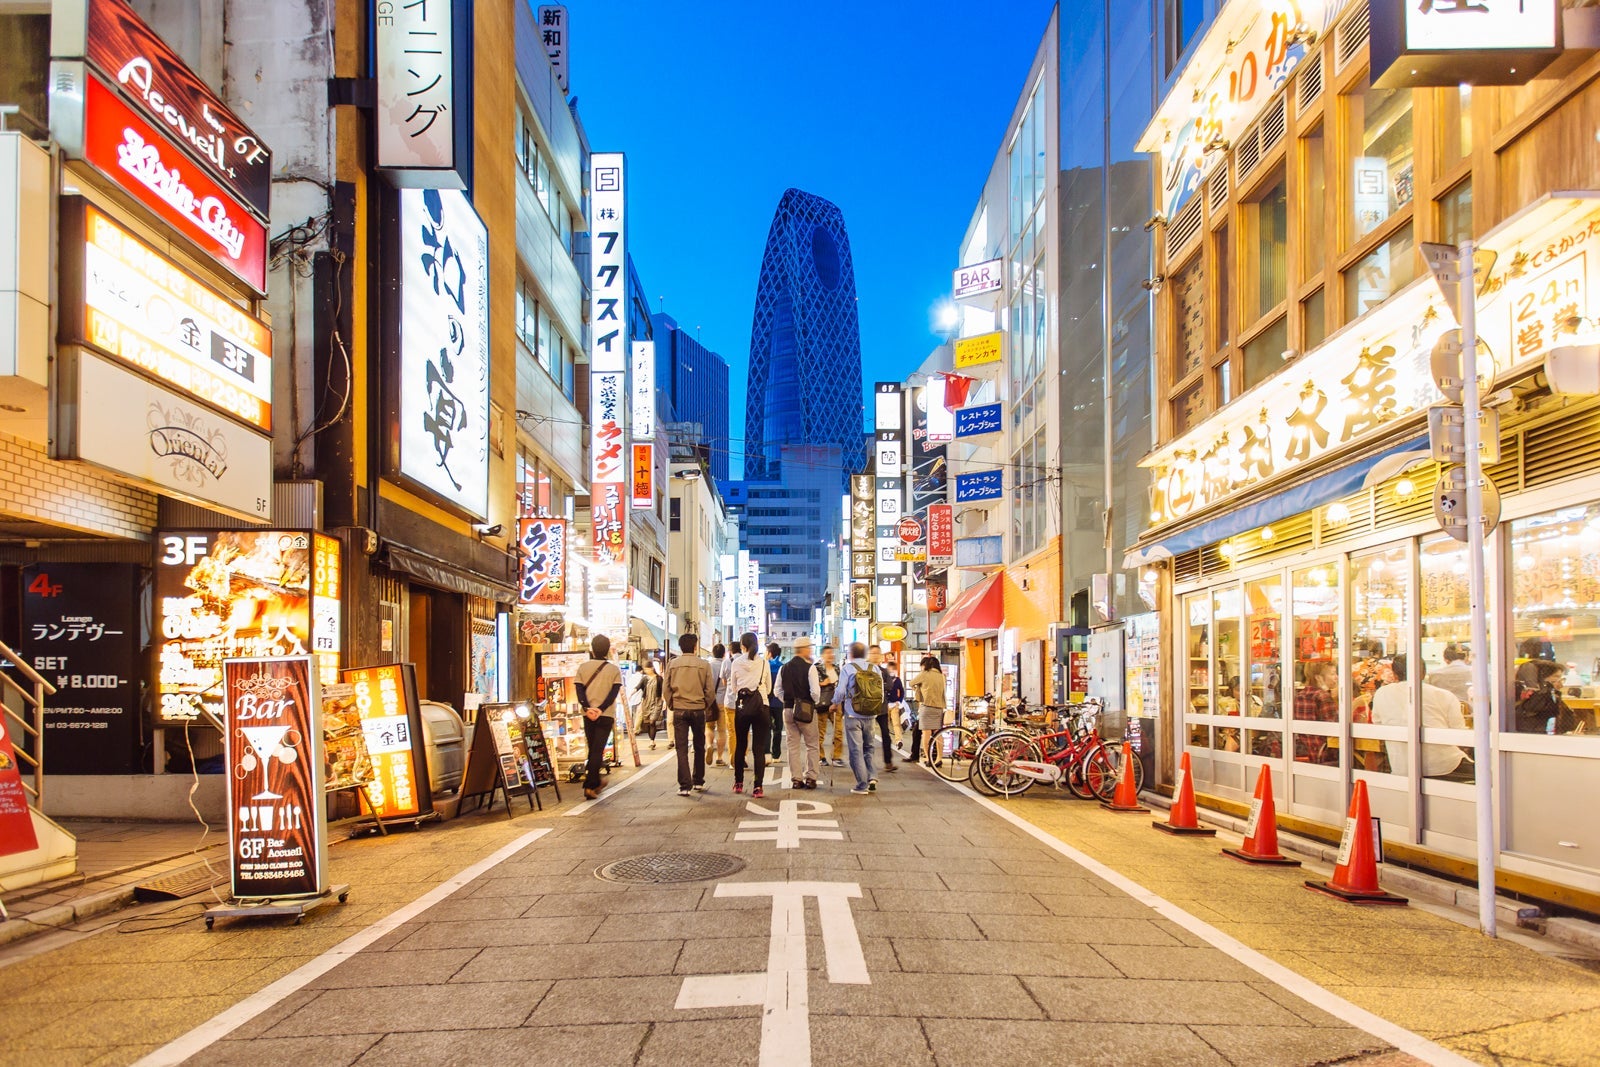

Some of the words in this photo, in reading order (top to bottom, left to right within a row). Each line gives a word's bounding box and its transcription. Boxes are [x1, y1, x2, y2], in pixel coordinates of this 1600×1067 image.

[117, 56, 227, 171] Accueil
[233, 136, 269, 166] 6F
[960, 267, 991, 288] BAR
[1516, 277, 1579, 323] 24h
[222, 340, 248, 374] 3F
[960, 348, 998, 363] チャンカヤ
[881, 384, 895, 393] 6F
[961, 409, 997, 421] レストラン
[882, 432, 895, 441] 5F
[149, 429, 228, 480] Oriental
[595, 420, 623, 480] ラーメン
[882, 480, 895, 489] 4F
[961, 475, 998, 486] レストラン
[256, 498, 267, 512] 5F
[899, 526, 921, 538] 消火栓
[931, 512, 940, 550] だるまや
[161, 536, 209, 566] 3F
[855, 554, 874, 562] 2F
[521, 521, 550, 602] ラーメン
[28, 572, 63, 598] 4F
[882, 577, 896, 585] 2F
[61, 615, 93, 624] Lounge
[520, 619, 565, 634] ラーメン
[31, 623, 124, 642] ランデヴー
[34, 656, 69, 671] SET
[235, 693, 296, 721] Bar
[239, 837, 266, 860] 6F
[266, 838, 286, 848] Bar
[266, 846, 303, 858] Accueil
